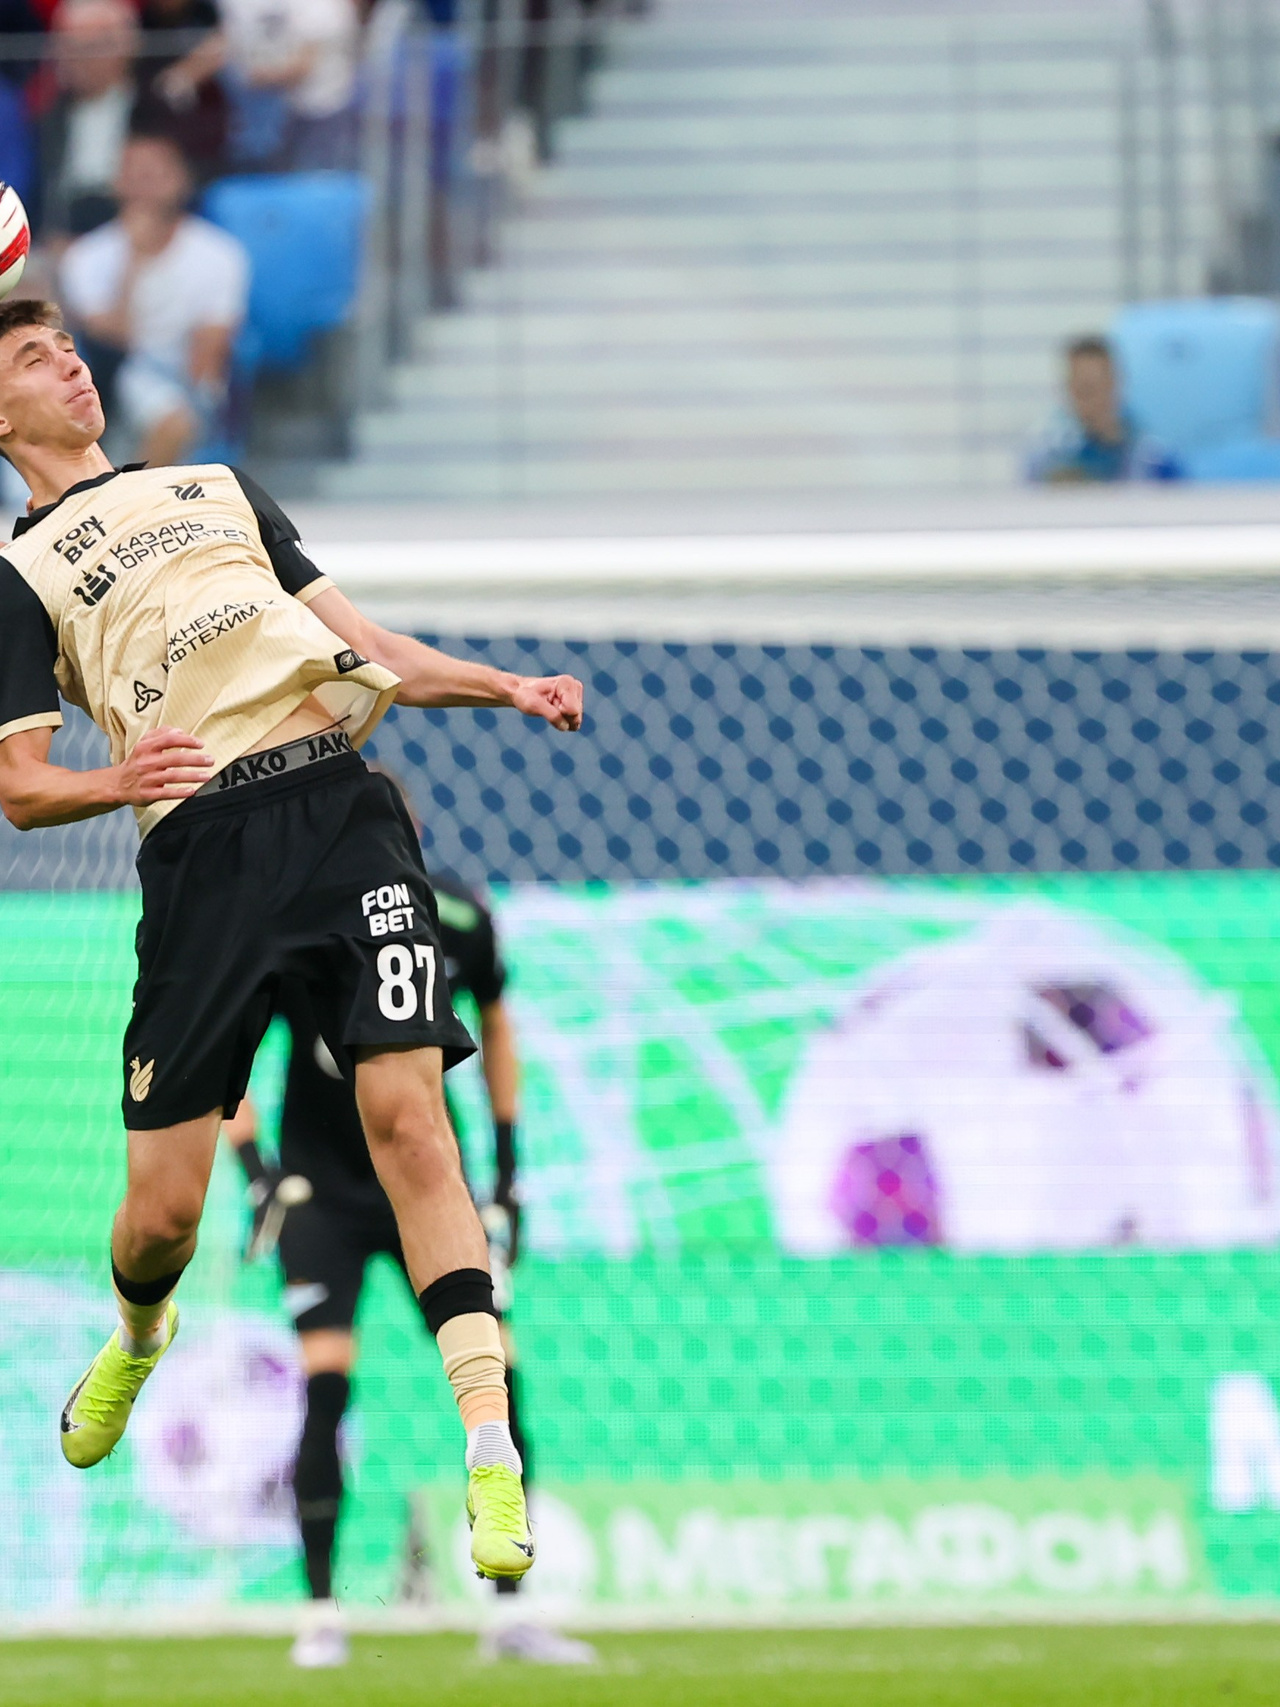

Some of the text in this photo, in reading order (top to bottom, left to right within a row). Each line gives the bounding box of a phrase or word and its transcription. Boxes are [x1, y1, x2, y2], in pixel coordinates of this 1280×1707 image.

[53, 515, 98, 554] FON
[63, 520, 107, 566] BET
[109, 520, 204, 558] КАЗАНЬ
[219, 751, 287, 789] JAKO
[361, 883, 410, 916] FON
[369, 906, 415, 936] BET
[376, 943, 436, 1022] 87
[606, 1504, 1192, 1600] МЕГАФОН
